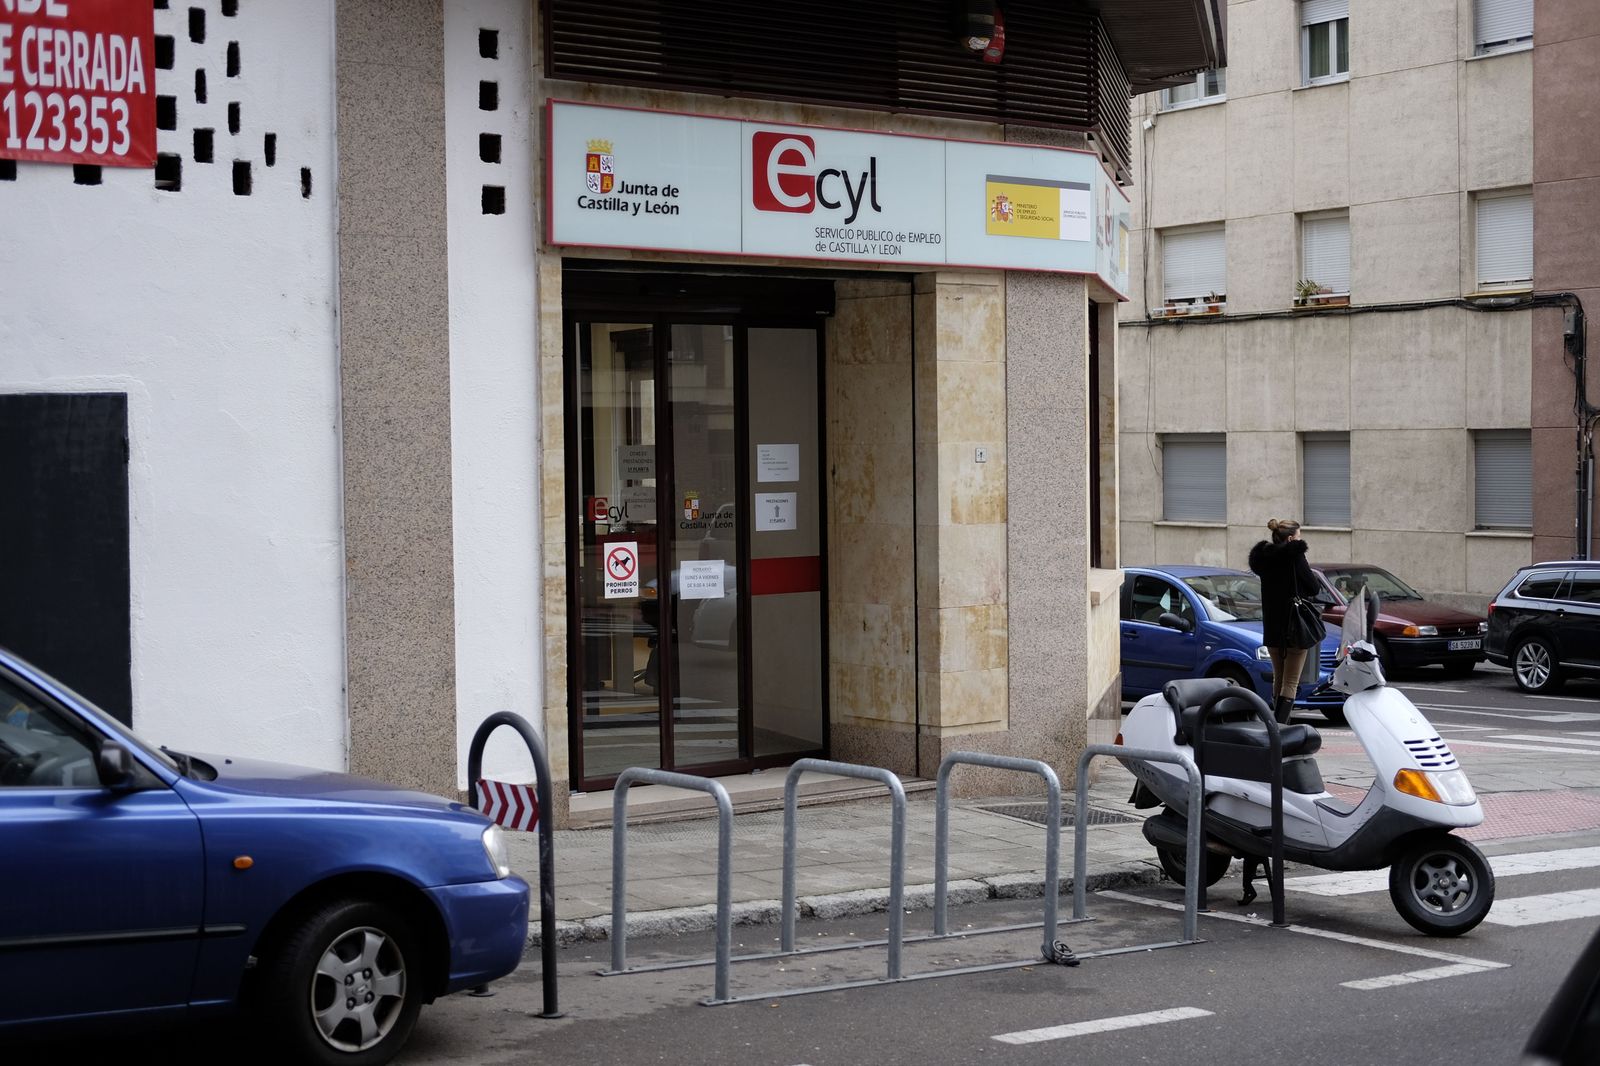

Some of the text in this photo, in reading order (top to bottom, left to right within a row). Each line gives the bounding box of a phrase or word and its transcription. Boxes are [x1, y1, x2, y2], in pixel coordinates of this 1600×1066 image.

[21, 25, 147, 94] CERRADA
[4, 89, 130, 156] 123353
[617, 181, 679, 198] Junta de
[577, 195, 680, 216] Castilla y León
[815, 227, 941, 245] SERVICIO PUBLICO de EMPLEO
[815, 241, 902, 256] de CASTILLA Y LEON
[701, 511, 734, 520] Junta de
[680, 521, 707, 529] Castilla
[714, 520, 734, 529] León
